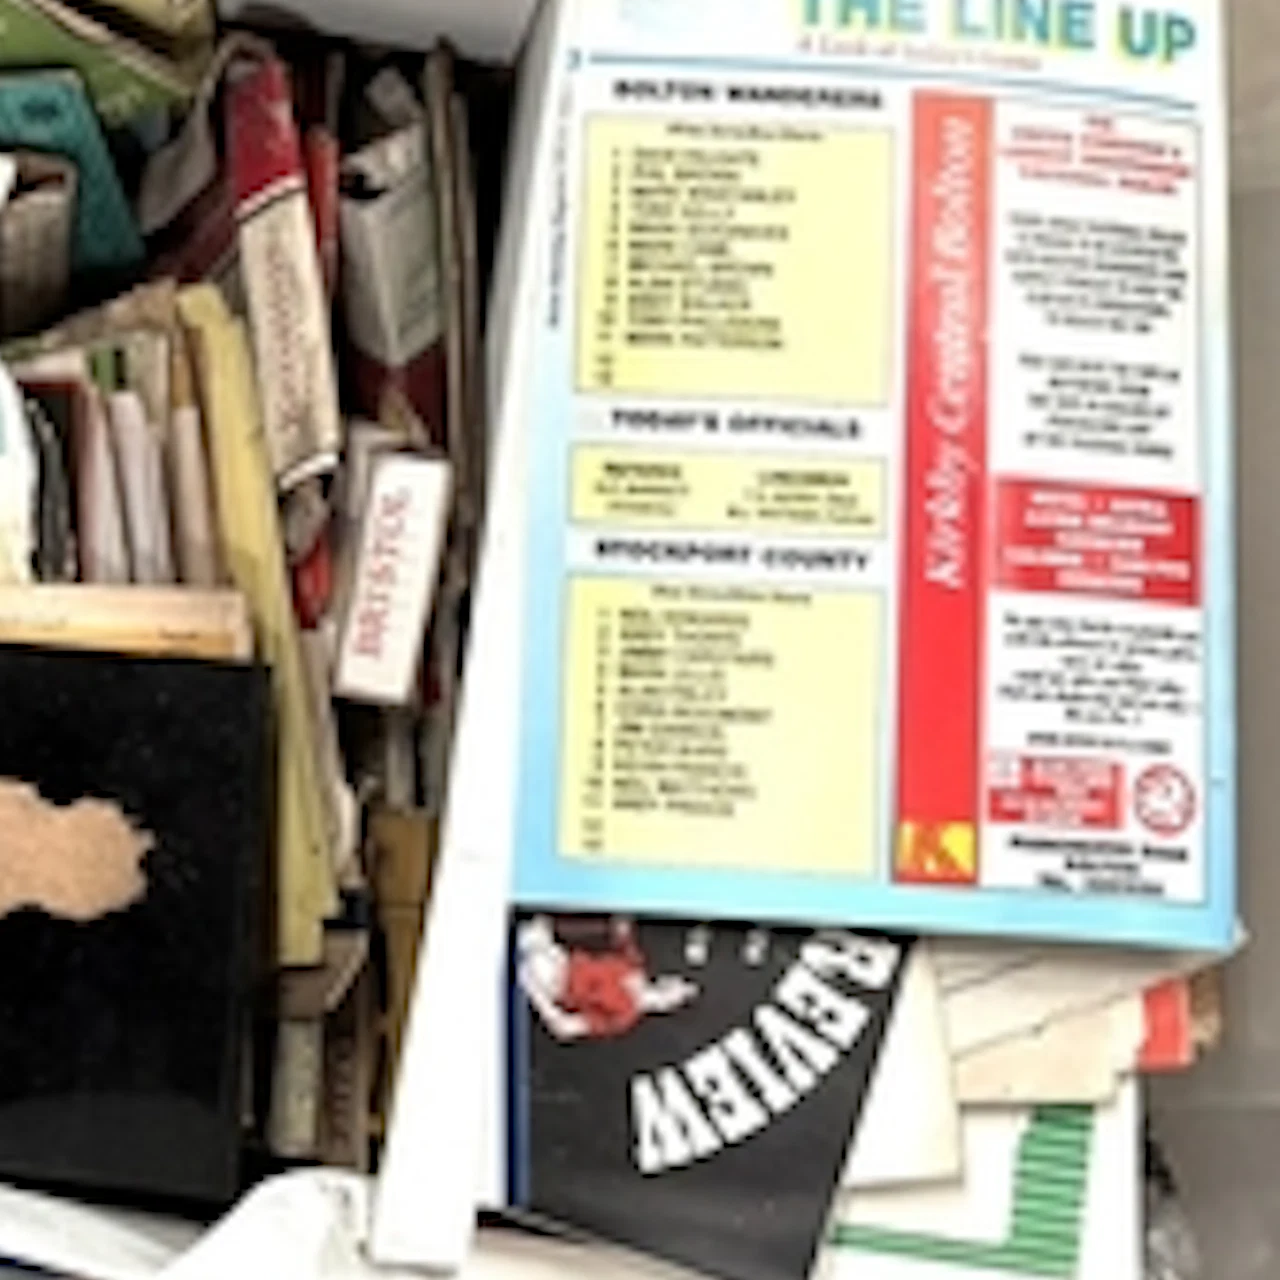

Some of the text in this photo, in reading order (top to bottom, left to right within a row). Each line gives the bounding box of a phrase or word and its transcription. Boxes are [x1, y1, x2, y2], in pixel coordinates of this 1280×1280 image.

[1117, 3, 1197, 63] UP
[613, 80, 883, 110] BOLTON WANDERERS
[929, 115, 976, 261] Bolton
[924, 263, 974, 435] Central
[726, 414, 862, 440] OFFICIALS
[595, 540, 870, 574] STOCKPORT COUNTY
[630, 930, 900, 1176] REVIEW
